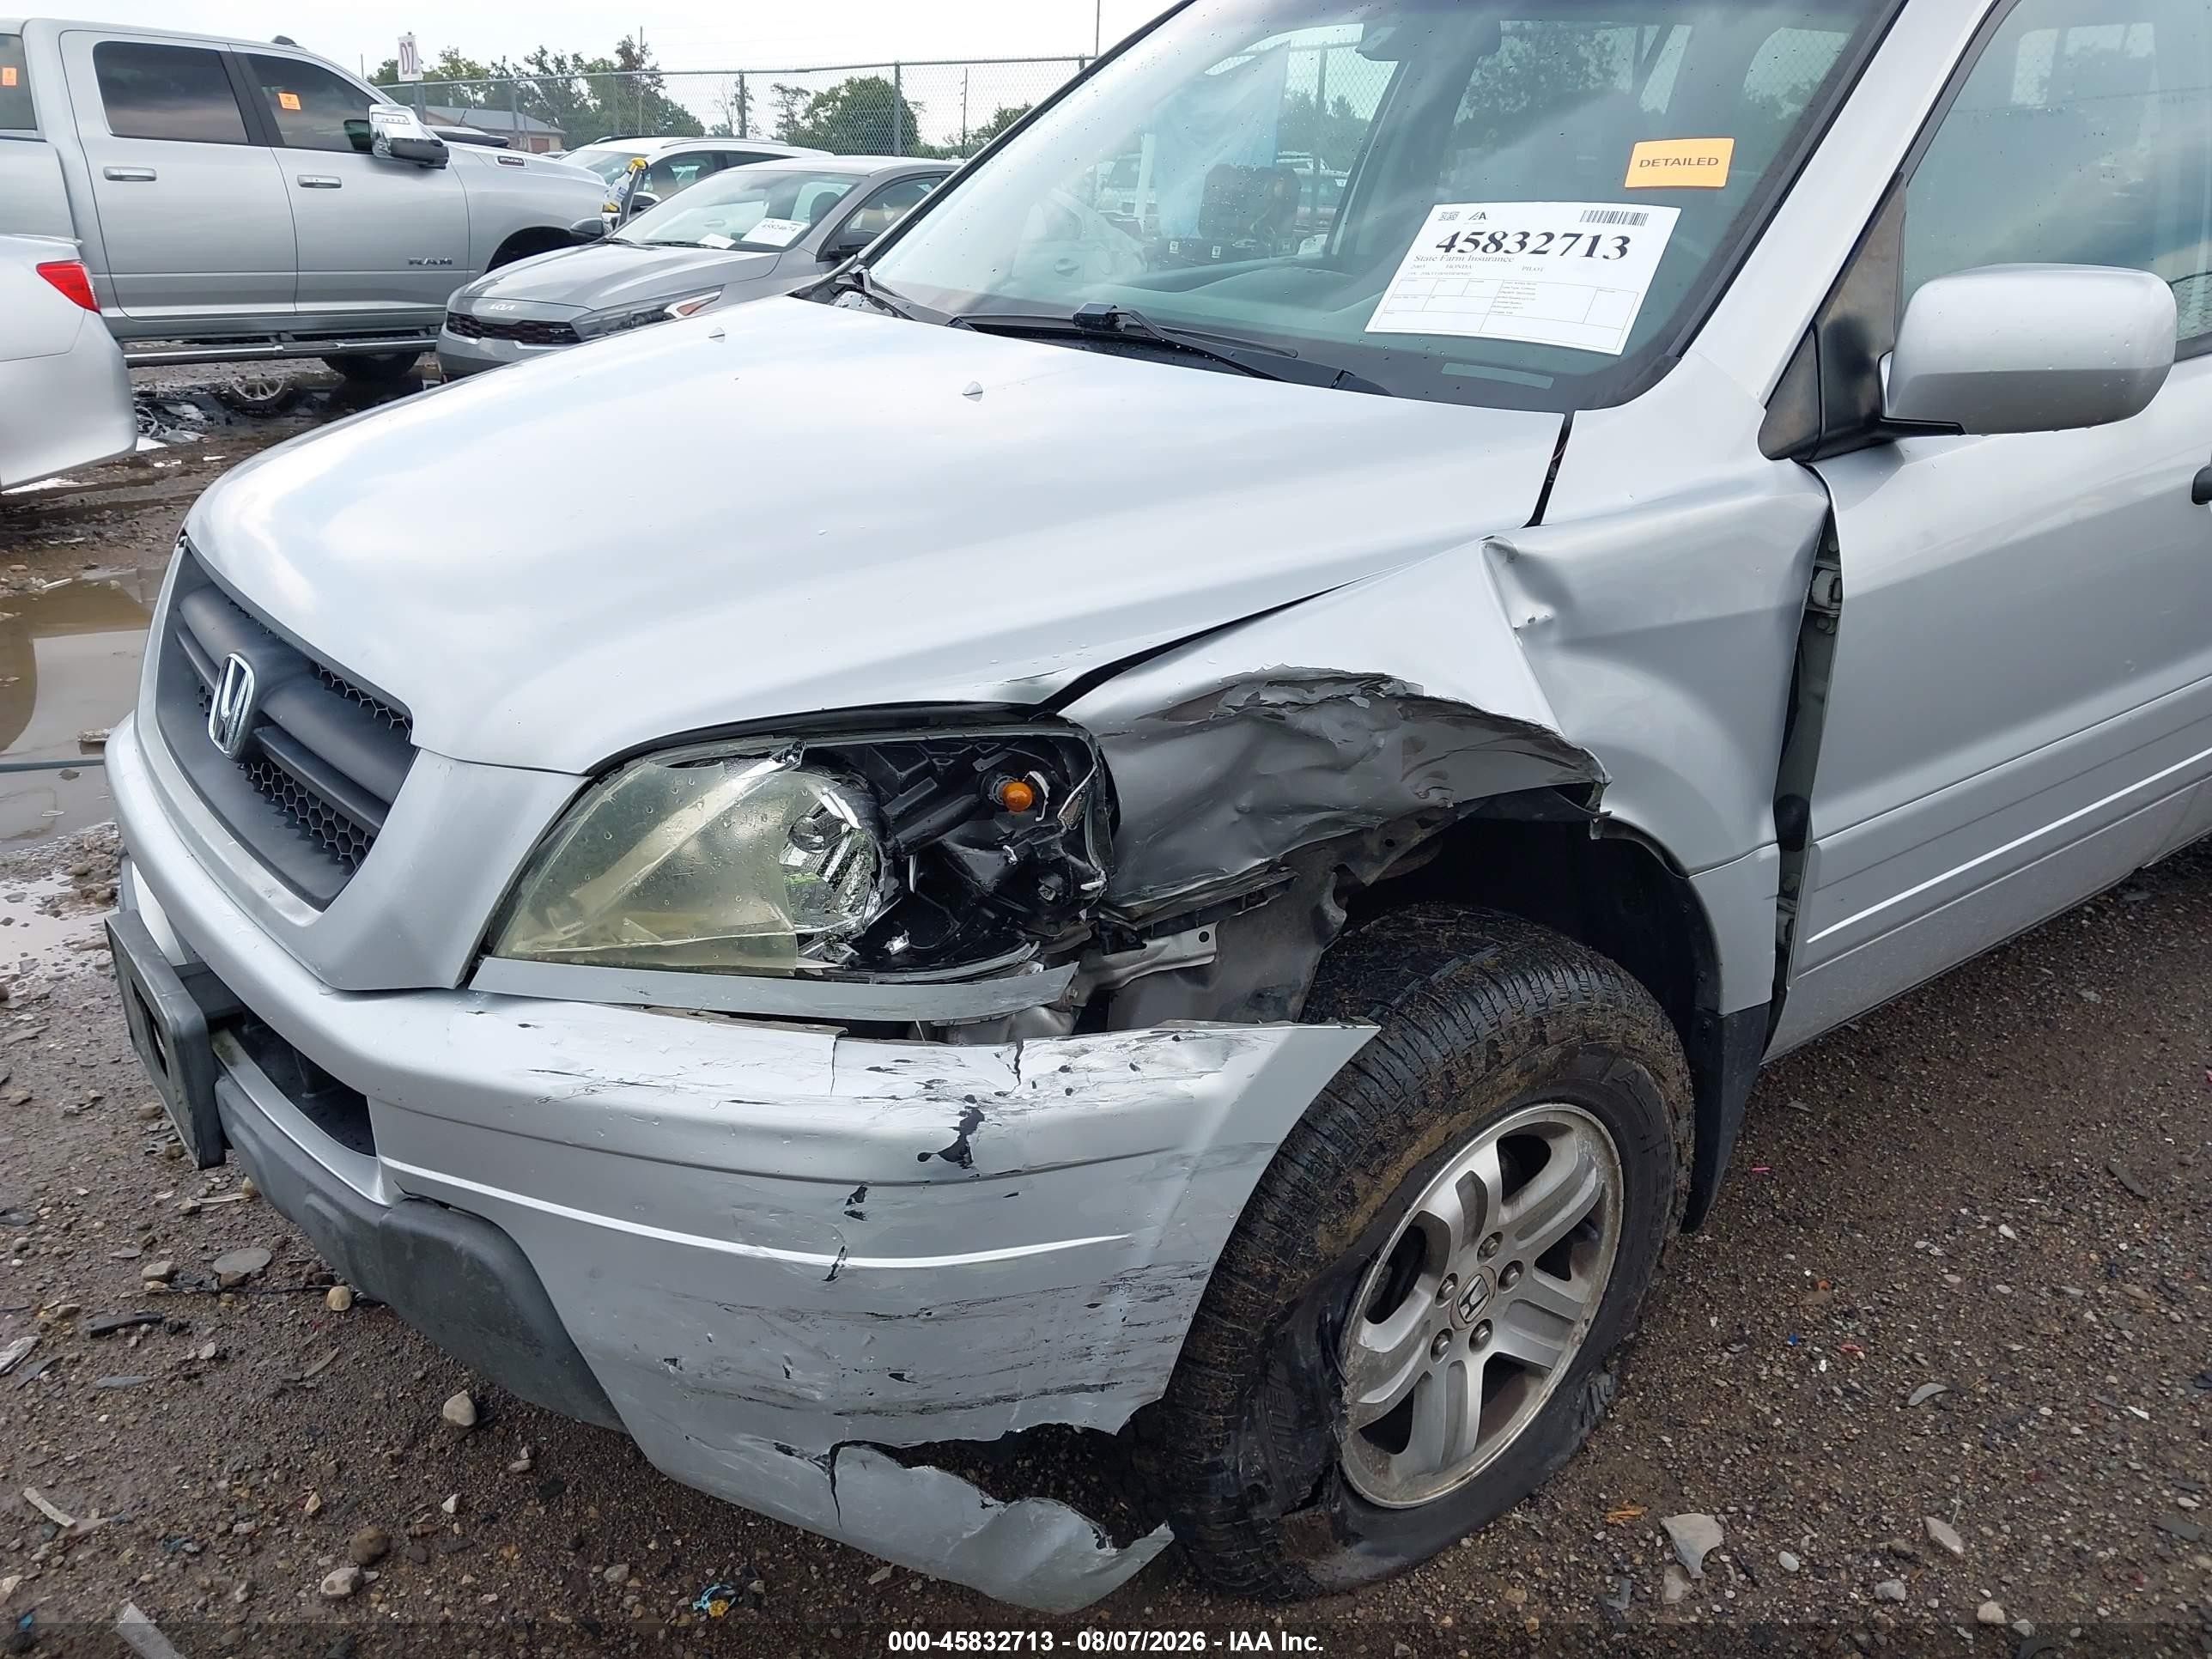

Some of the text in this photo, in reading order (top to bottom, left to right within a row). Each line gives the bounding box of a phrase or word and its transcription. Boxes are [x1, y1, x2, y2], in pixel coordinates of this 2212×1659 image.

[1638, 157, 1719, 168] DETAILED
[1435, 230, 1632, 260] 45832713
[408, 257, 453, 266] RAM
[1467, 254, 1515, 263] Insurance
